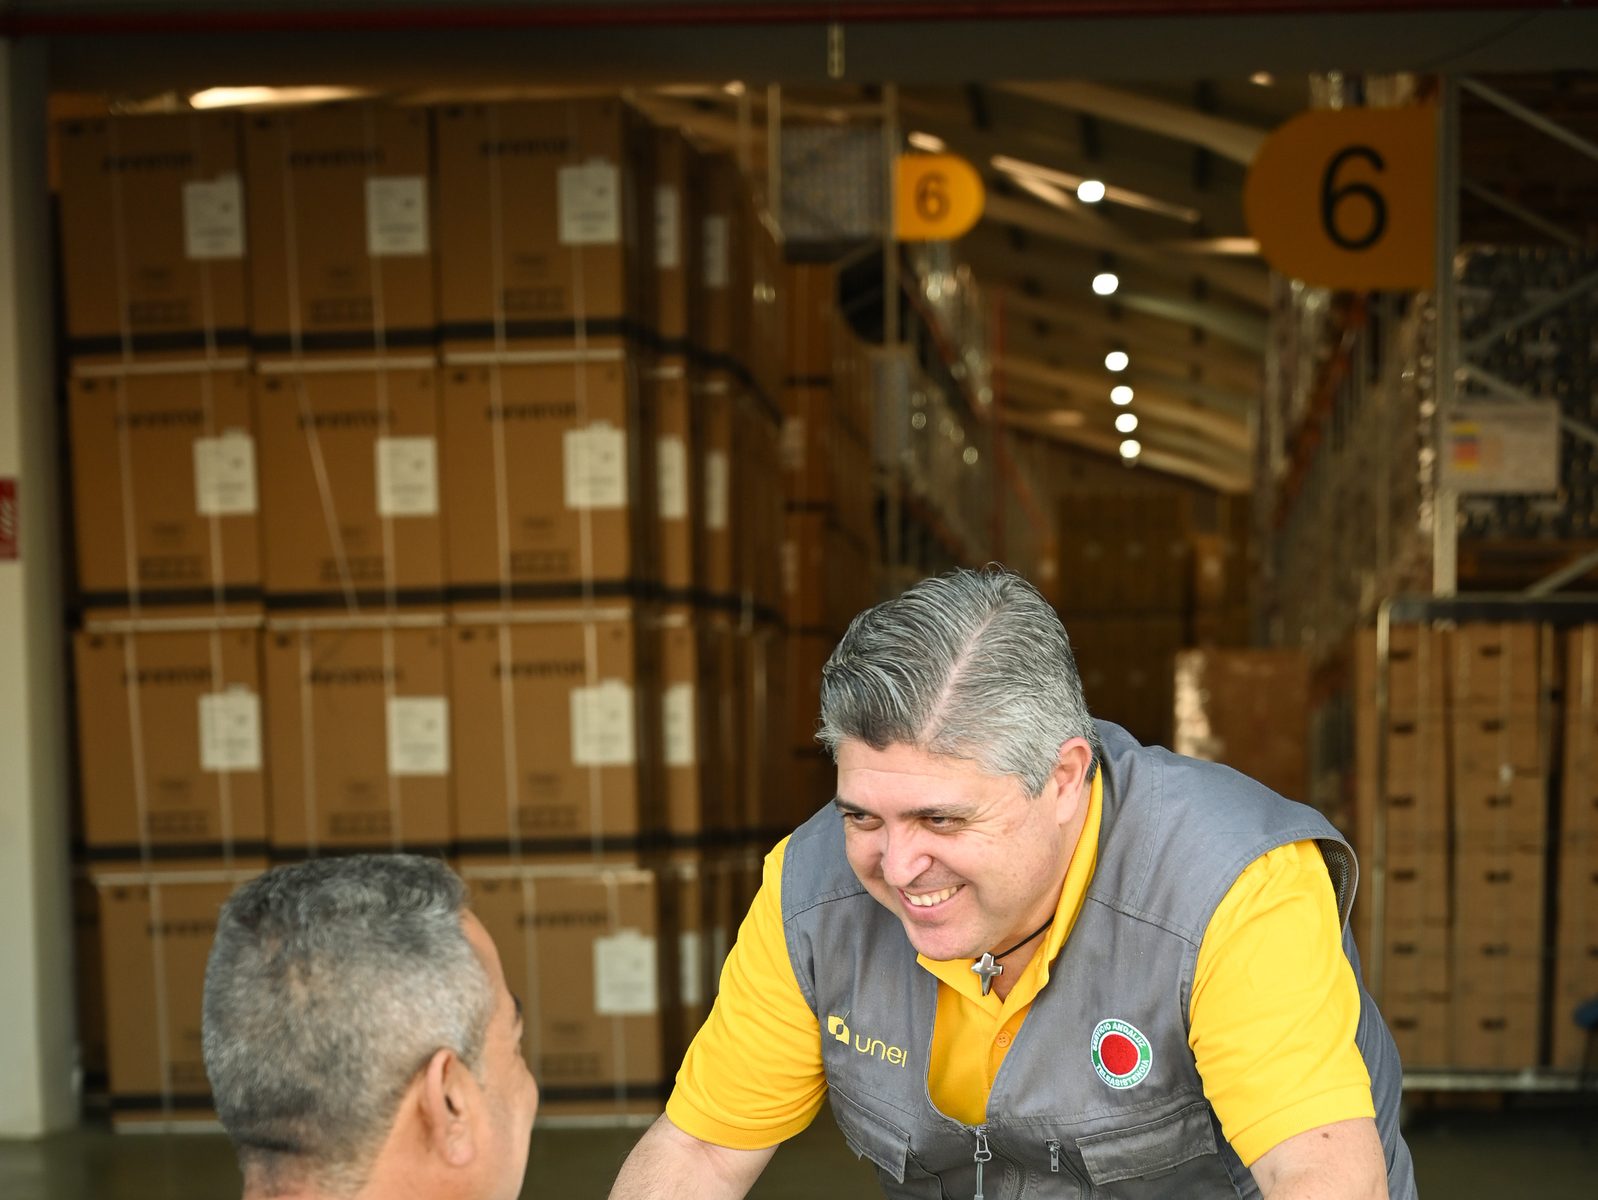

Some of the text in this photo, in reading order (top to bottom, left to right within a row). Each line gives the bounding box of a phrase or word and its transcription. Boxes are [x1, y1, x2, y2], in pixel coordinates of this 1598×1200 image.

[915, 171, 950, 223] 6
[1323, 144, 1388, 251] 6
[1092, 1022, 1147, 1051] SERVICIO ANDALUZ
[1096, 1060, 1150, 1086] TELEASISTENCIA
